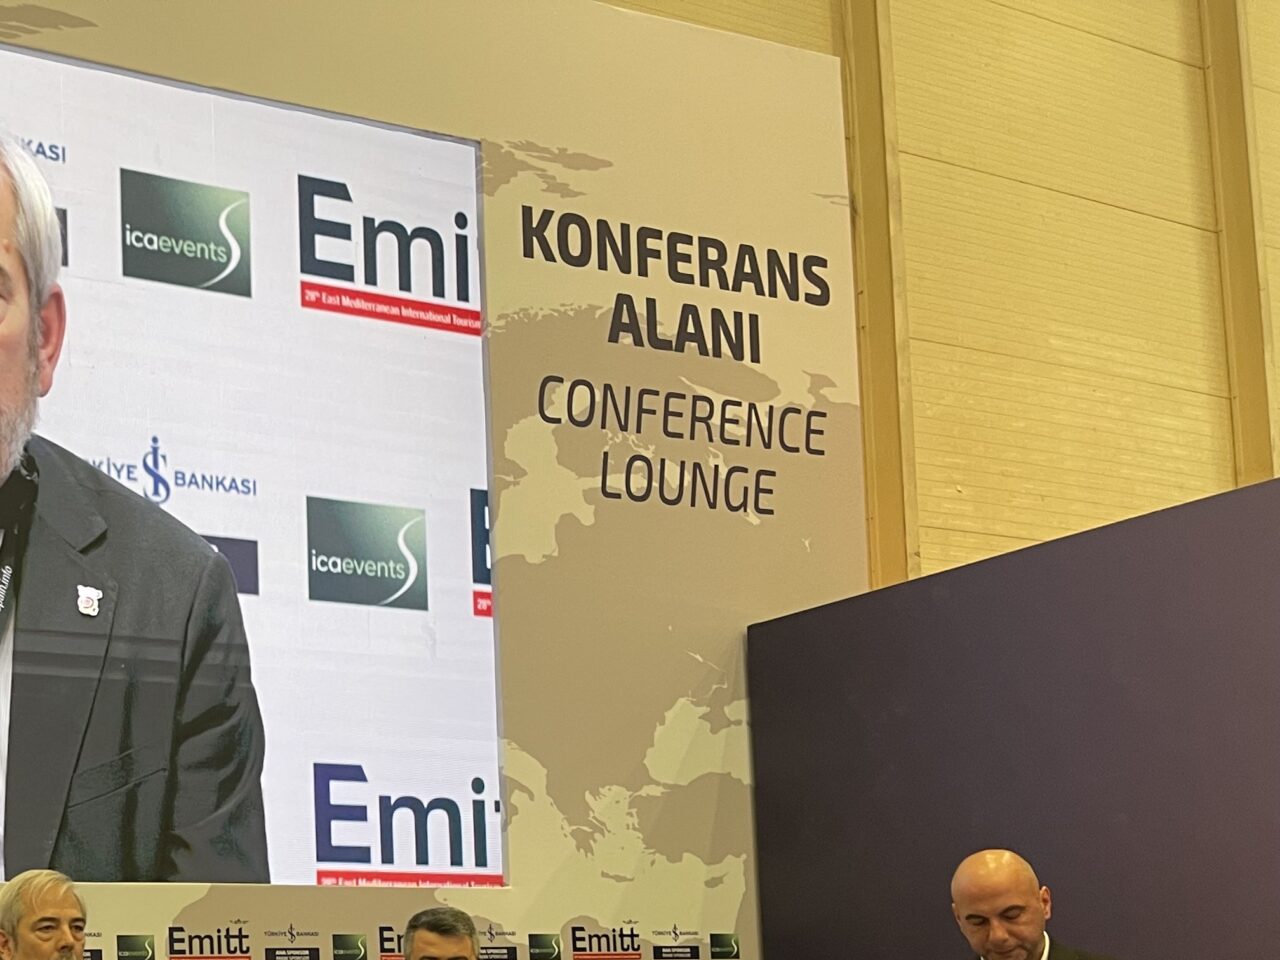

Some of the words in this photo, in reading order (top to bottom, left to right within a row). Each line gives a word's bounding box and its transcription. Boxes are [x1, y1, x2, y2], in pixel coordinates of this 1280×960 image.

[125, 224, 227, 263] icaevents
[521, 205, 831, 306] KONFERANS
[607, 293, 761, 364] ALANI
[538, 375, 828, 456] CONFERENCE
[174, 470, 258, 497] BANKASI
[600, 451, 777, 516] LOUNGE
[311, 549, 405, 580] icaevents
[168, 926, 250, 956] Emitt
[571, 926, 641, 954] Emitt
